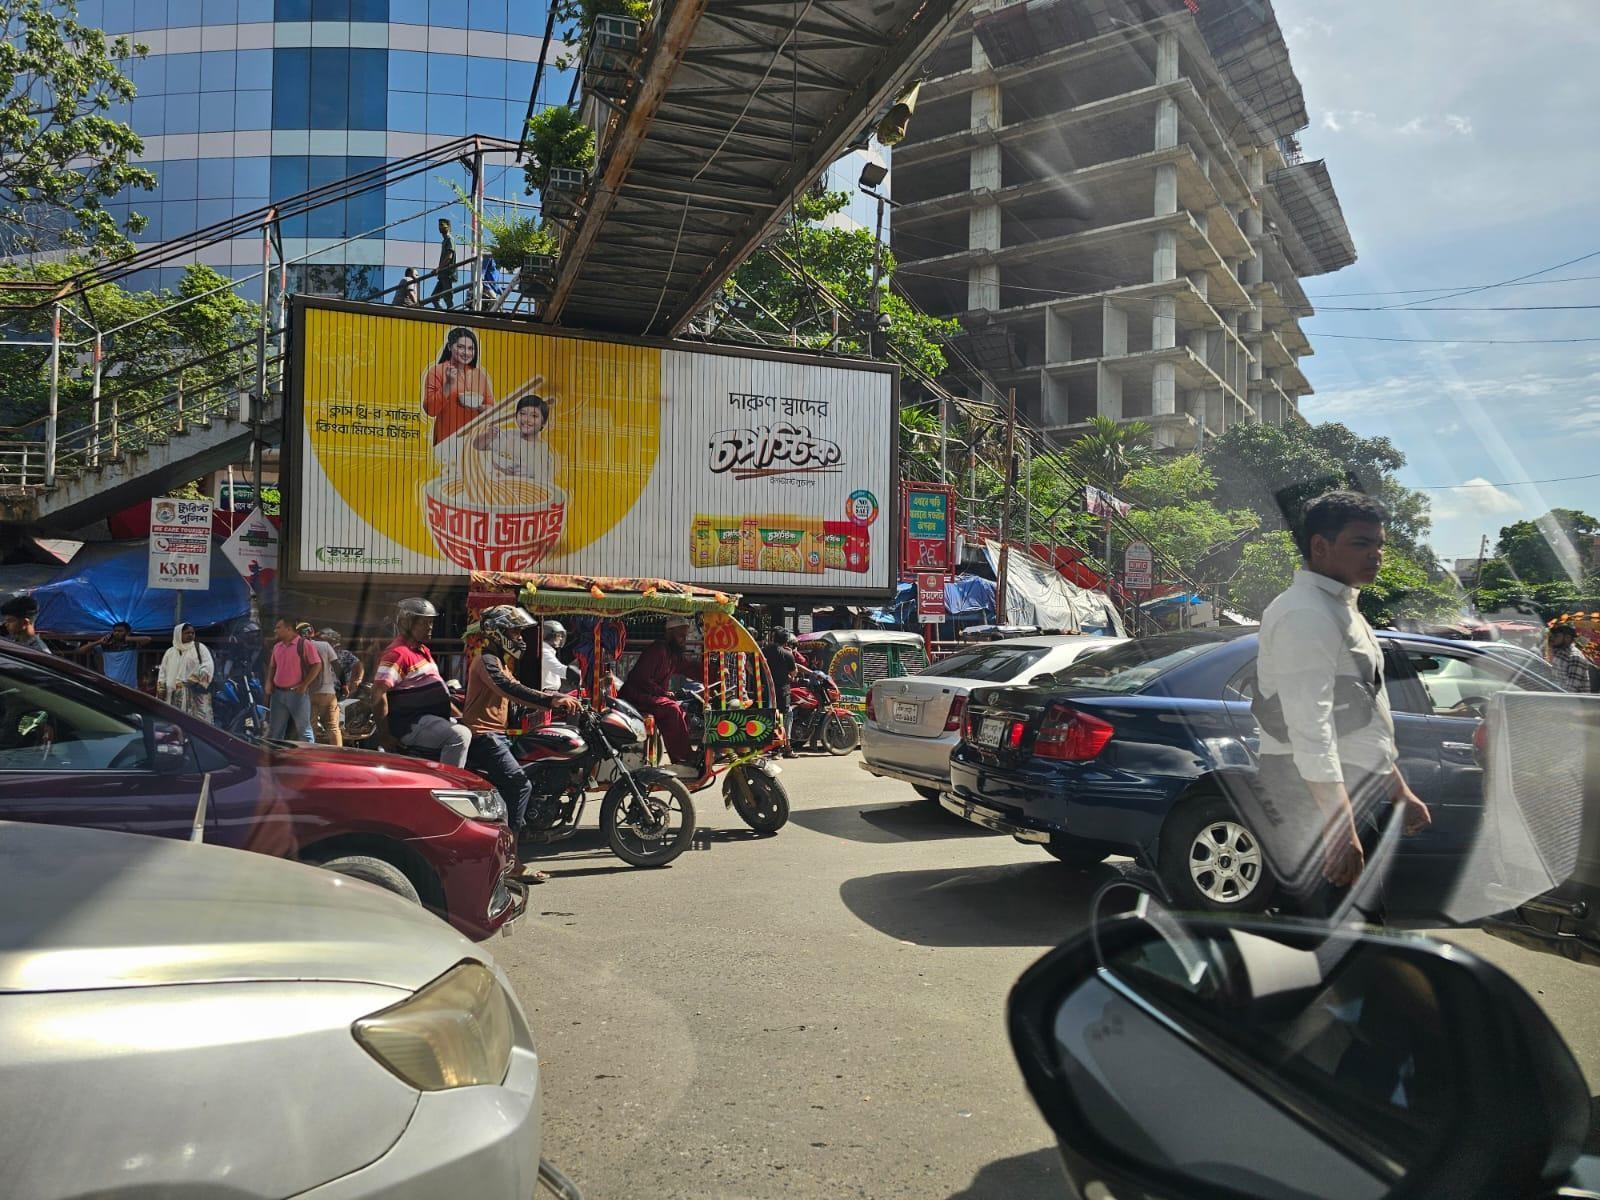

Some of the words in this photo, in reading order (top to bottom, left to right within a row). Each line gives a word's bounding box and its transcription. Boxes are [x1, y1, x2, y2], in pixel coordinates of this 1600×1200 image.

[729, 392, 778, 412] দারুণ
[780, 397, 829, 418] স্বাদের
[427, 494, 490, 549] সবার
[160, 562, 200, 577] KSRM
